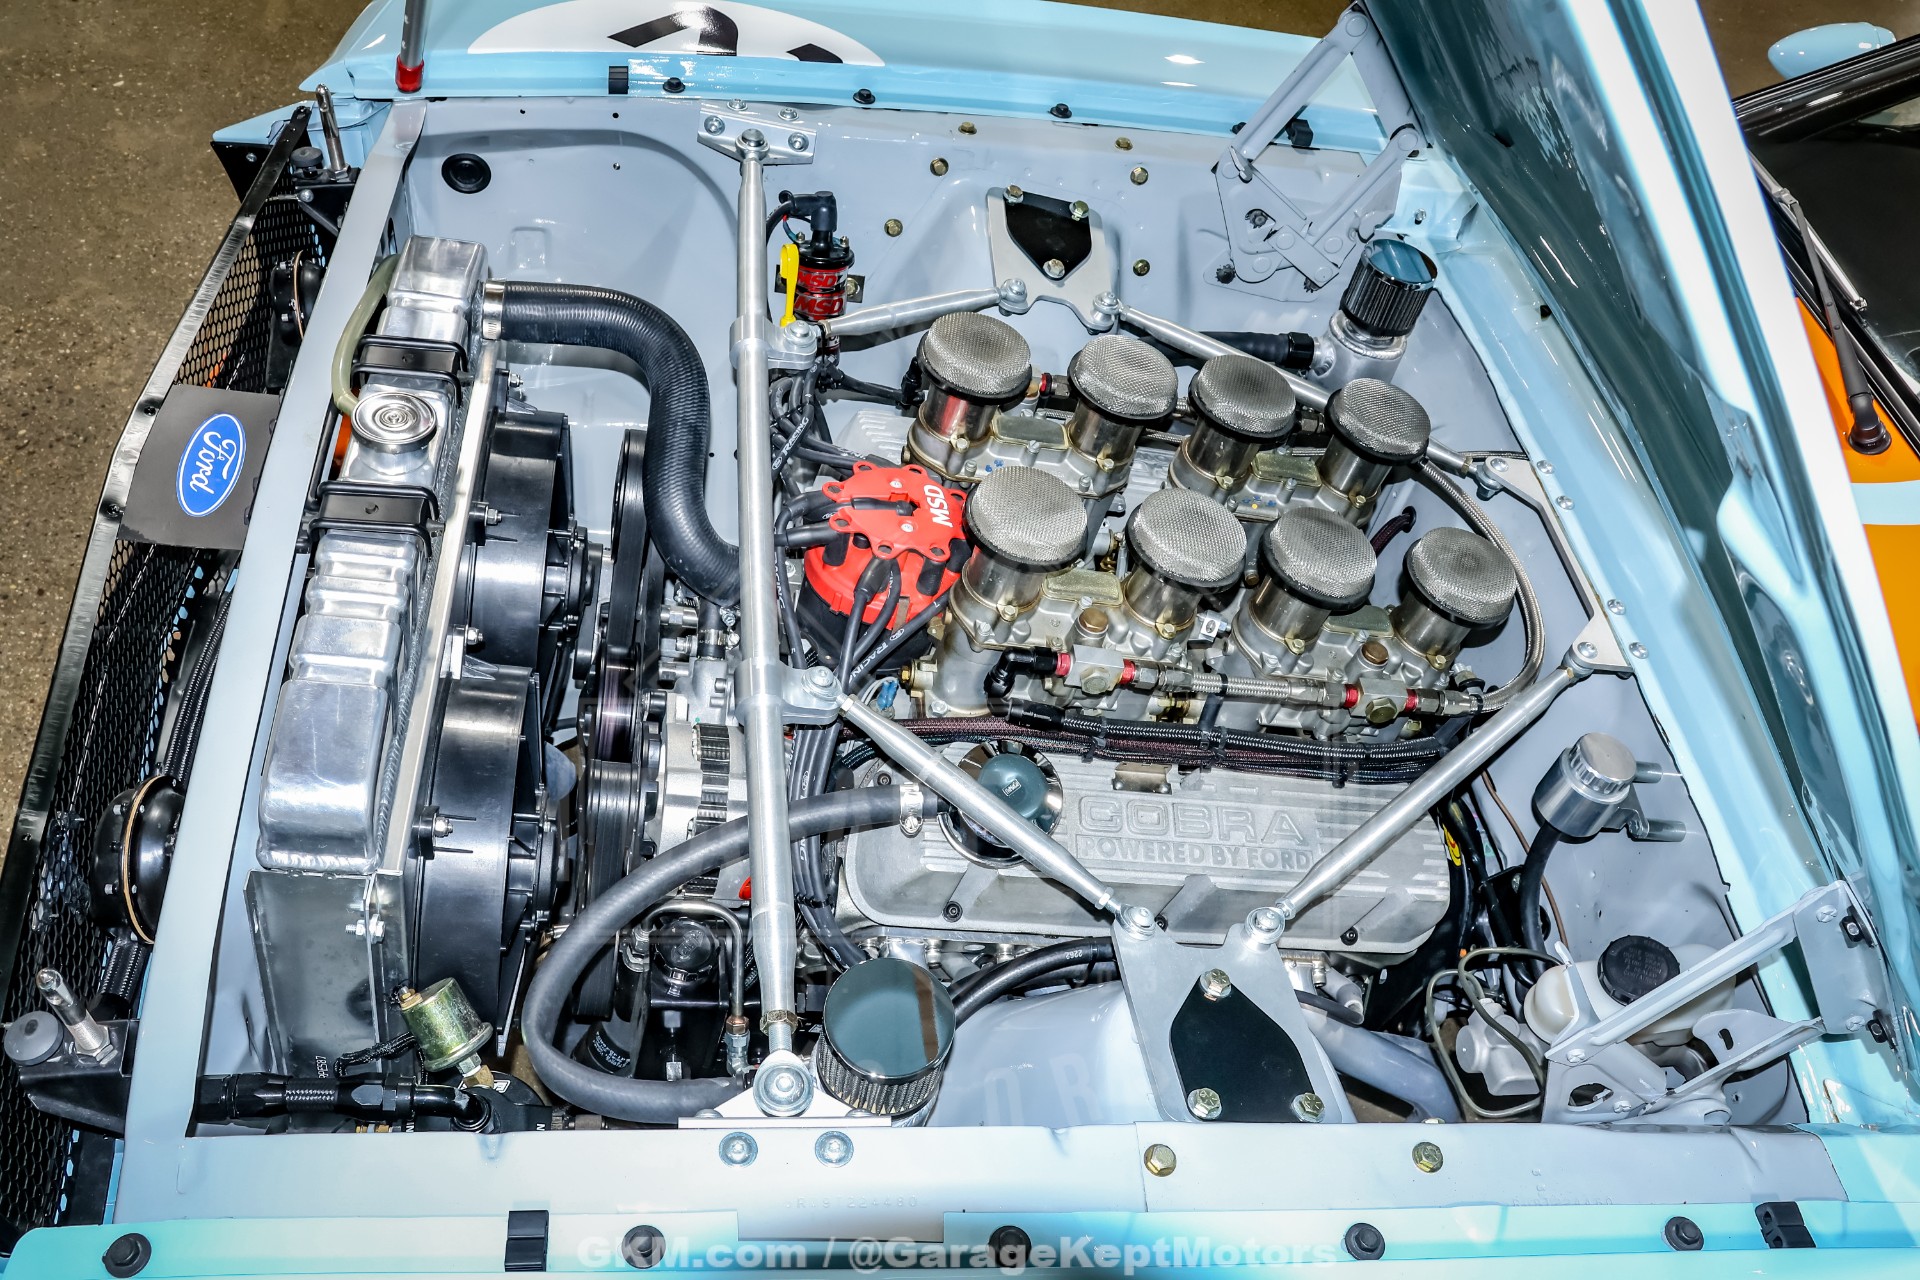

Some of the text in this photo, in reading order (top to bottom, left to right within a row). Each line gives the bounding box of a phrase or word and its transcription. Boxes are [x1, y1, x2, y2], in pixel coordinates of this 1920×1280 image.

[796, 271, 838, 288] MSD
[794, 297, 844, 315] MSD
[782, 416, 809, 457] RACING
[189, 431, 237, 495] Ford
[923, 484, 953, 528] MSD
[1080, 796, 1304, 844] COBRA
[1083, 837, 1313, 870] POWERED BY FORD
